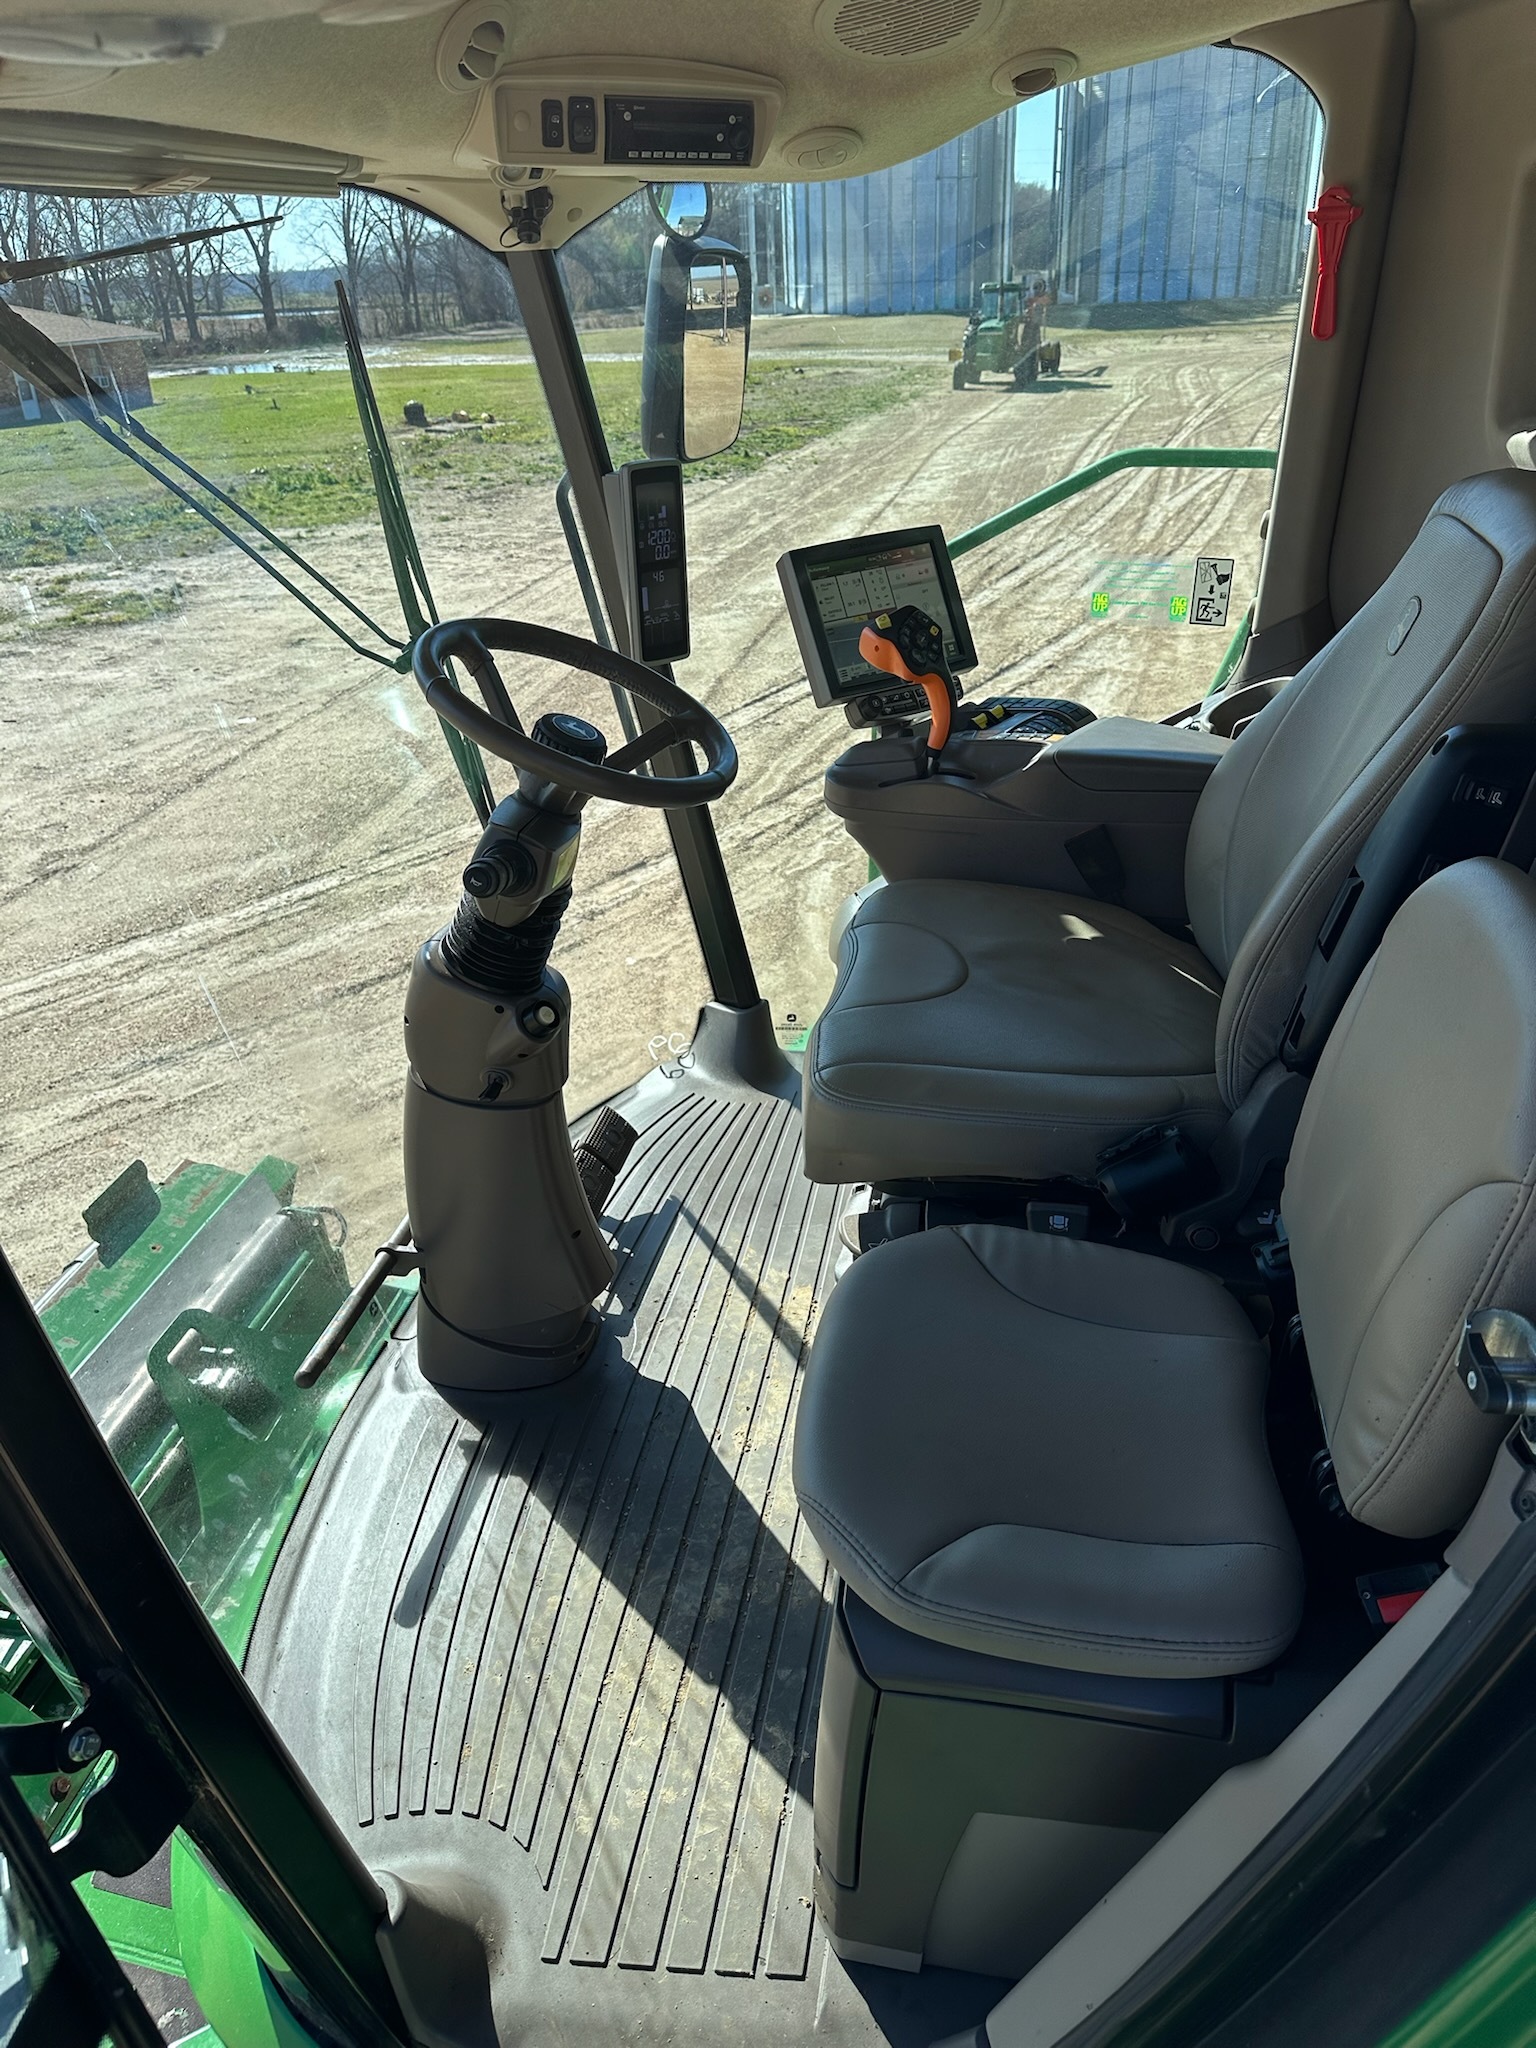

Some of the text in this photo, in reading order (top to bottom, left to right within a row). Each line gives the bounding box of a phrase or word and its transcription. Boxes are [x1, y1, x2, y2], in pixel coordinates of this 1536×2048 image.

[648, 529, 670, 545] 1200
[655, 545, 670, 560] 0.0
[653, 570, 665, 582] 46
[1093, 593, 1108, 603] AG
[1172, 597, 1187, 607] AG
[1092, 602, 1108, 612] UP
[1171, 606, 1187, 616] UP
